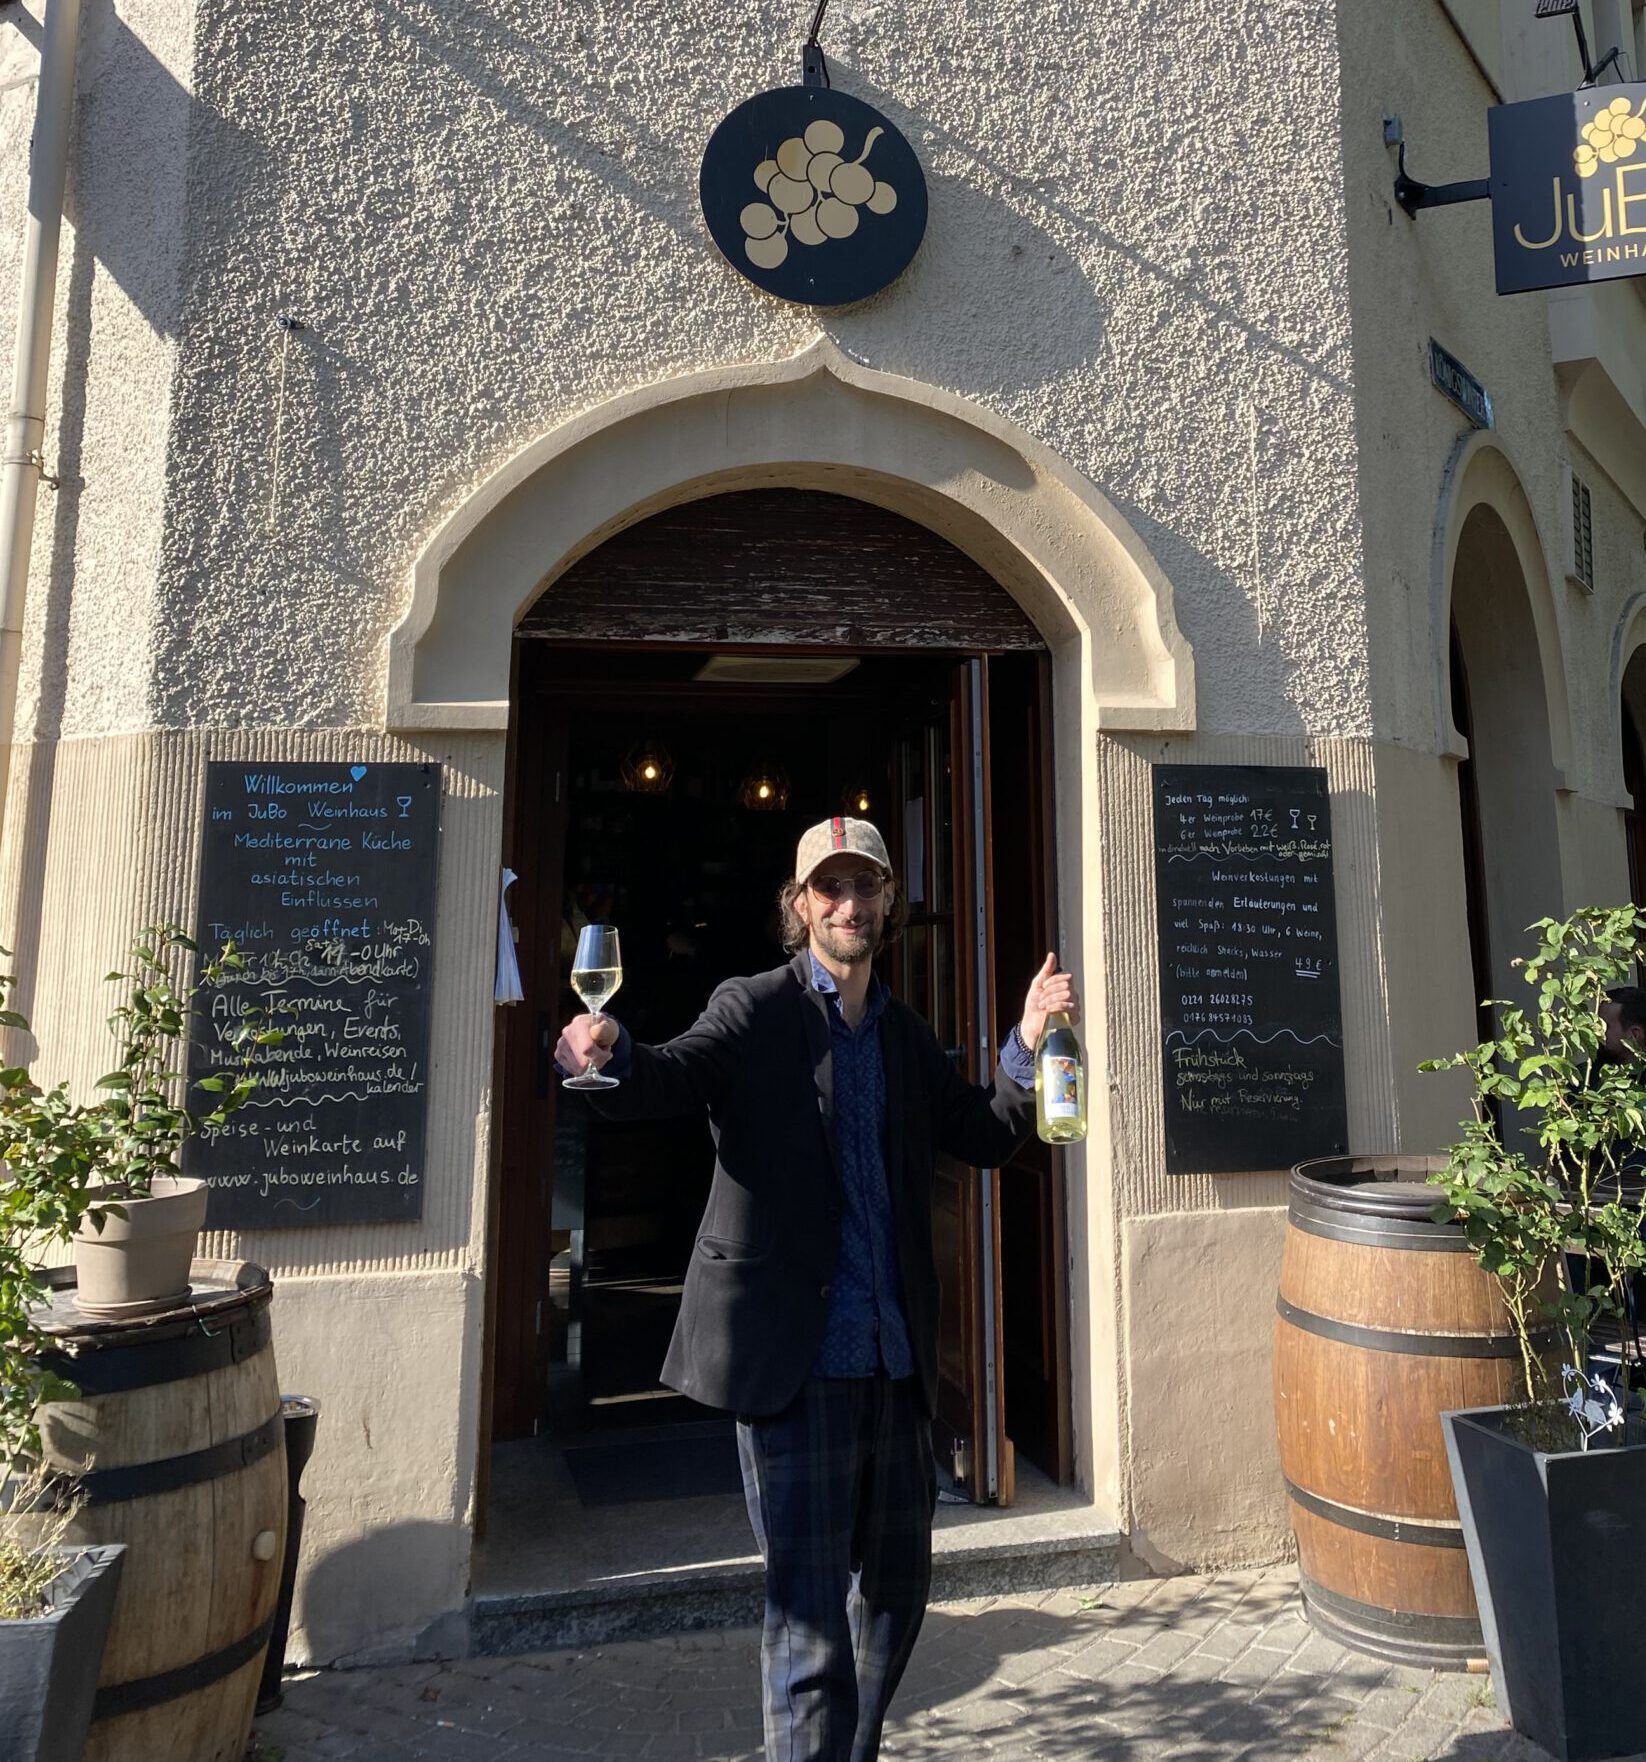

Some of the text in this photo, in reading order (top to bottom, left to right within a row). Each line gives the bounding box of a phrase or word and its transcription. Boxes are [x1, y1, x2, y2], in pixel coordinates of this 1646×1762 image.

[1560, 244, 1646, 268] WEINH
[244, 774, 353, 794] Willkommen
[211, 799, 388, 821] im JuBo Weinhaus
[1165, 795, 1193, 806] Jeden
[1197, 794, 1213, 809] Tag
[1203, 811, 1244, 827] Weinprobe
[234, 831, 412, 850] Mediterrane Küche
[285, 852, 317, 868] mit
[251, 870, 360, 886] asiatischen
[1211, 870, 1319, 888] Weinverkostungen mit
[1302, 902, 1319, 913] und
[208, 922, 274, 945] Täglich
[1174, 918, 1189, 929] viel
[1285, 926, 1291, 936] 6
[1251, 948, 1282, 958] Wasser
[212, 989, 399, 1018] Alle Termine für
[1181, 995, 1203, 1006] 0221
[1183, 1012, 1206, 1023] 0176
[213, 1018, 335, 1042] Vekostungen,
[325, 1043, 407, 1059] Weinreisen
[1239, 1067, 1259, 1081] und
[366, 1080, 424, 1095] kalender
[1181, 1089, 1205, 1111] Nur
[264, 1130, 407, 1158] Weinkarte auf
